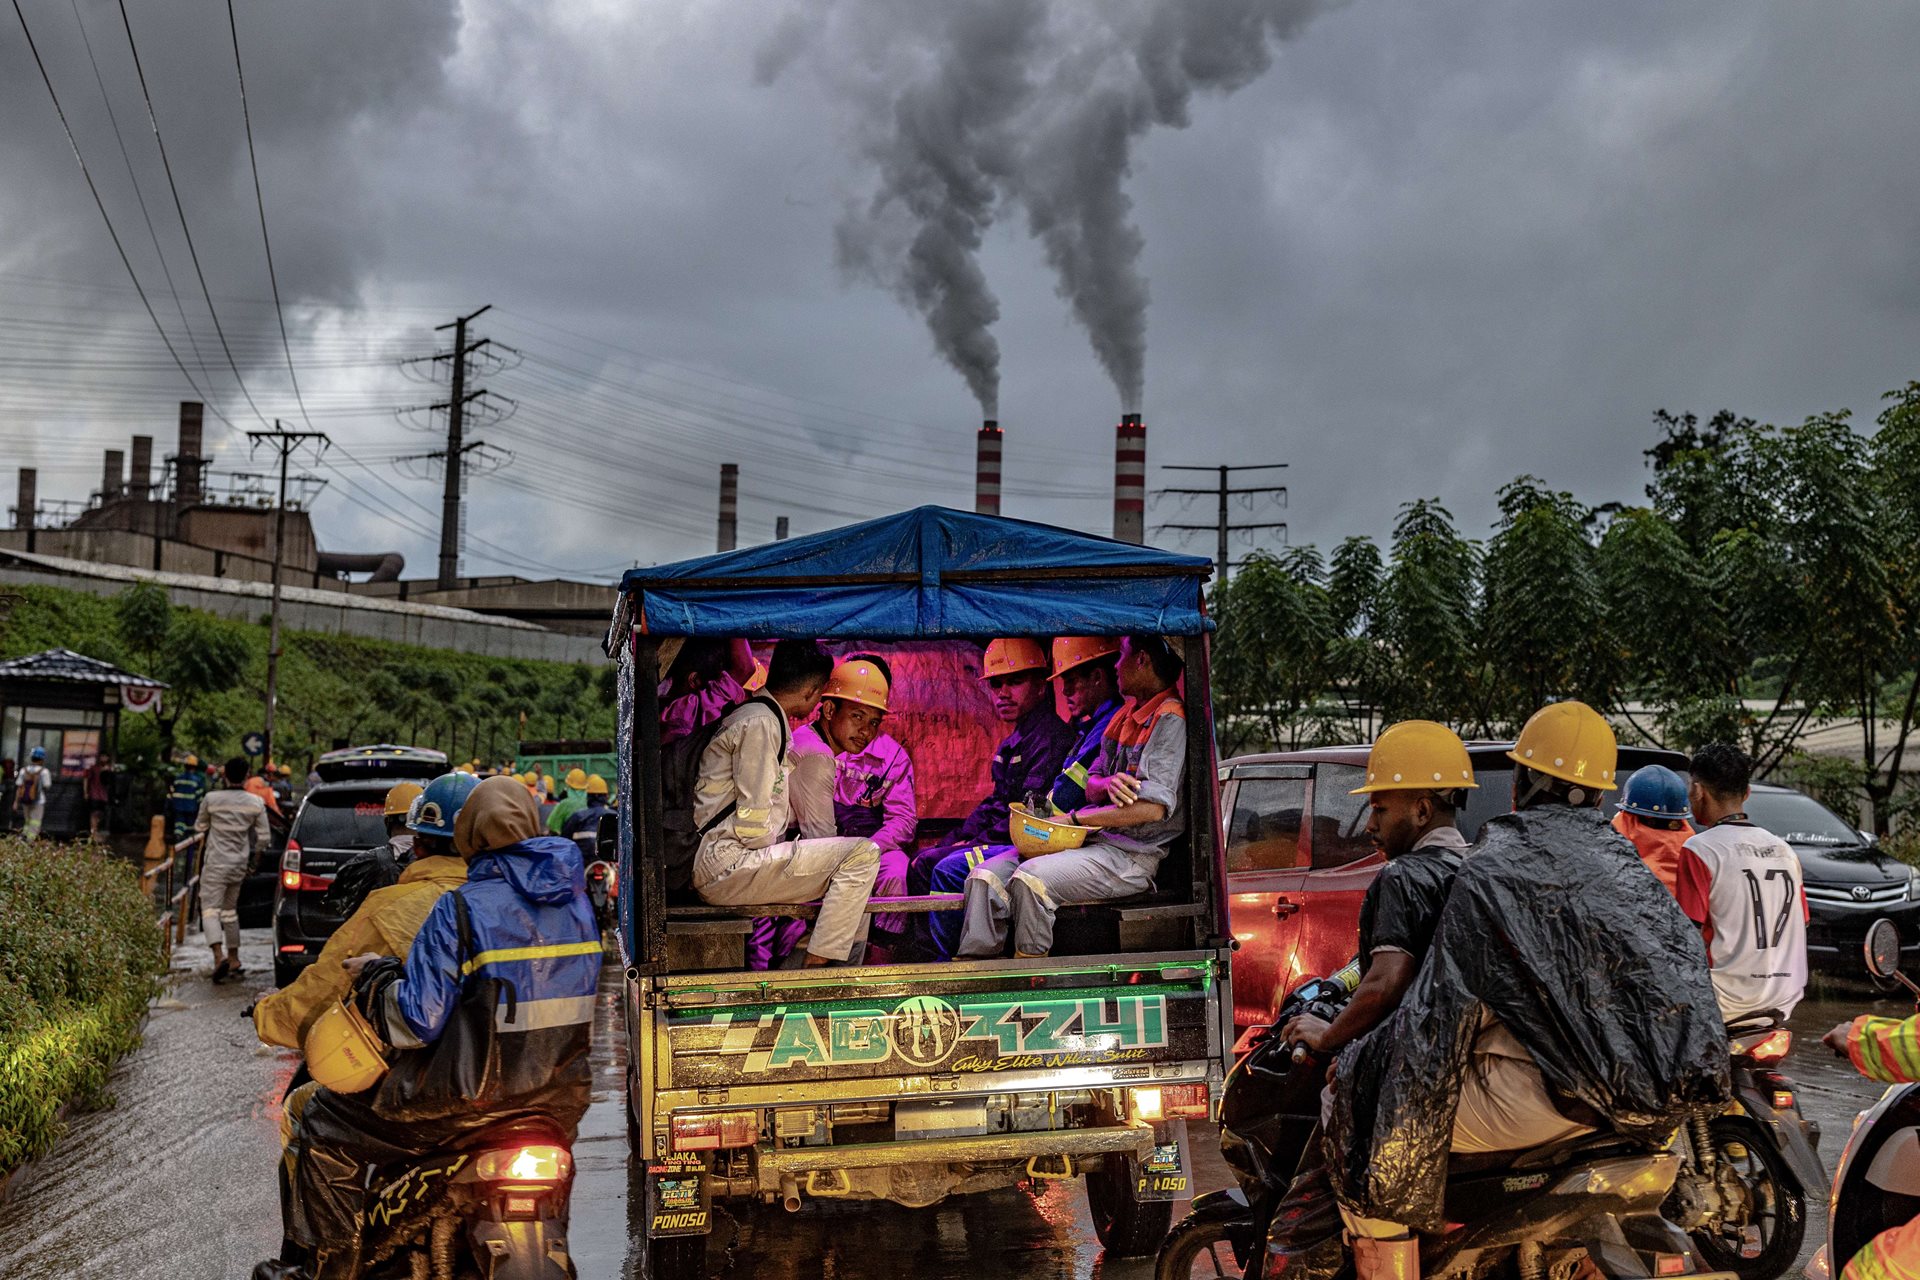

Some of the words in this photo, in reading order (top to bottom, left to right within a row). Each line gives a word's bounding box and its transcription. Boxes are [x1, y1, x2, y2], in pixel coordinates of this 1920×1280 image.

[1791, 831, 1840, 843] Edition
[1741, 868, 1794, 949] 17
[992, 1055, 1043, 1072] Elite
[1097, 1048, 1148, 1064] Sulit
[1137, 1177, 1187, 1193] PNOSO
[662, 1189, 696, 1199] CCTV
[651, 1212, 707, 1230] PONOSO
